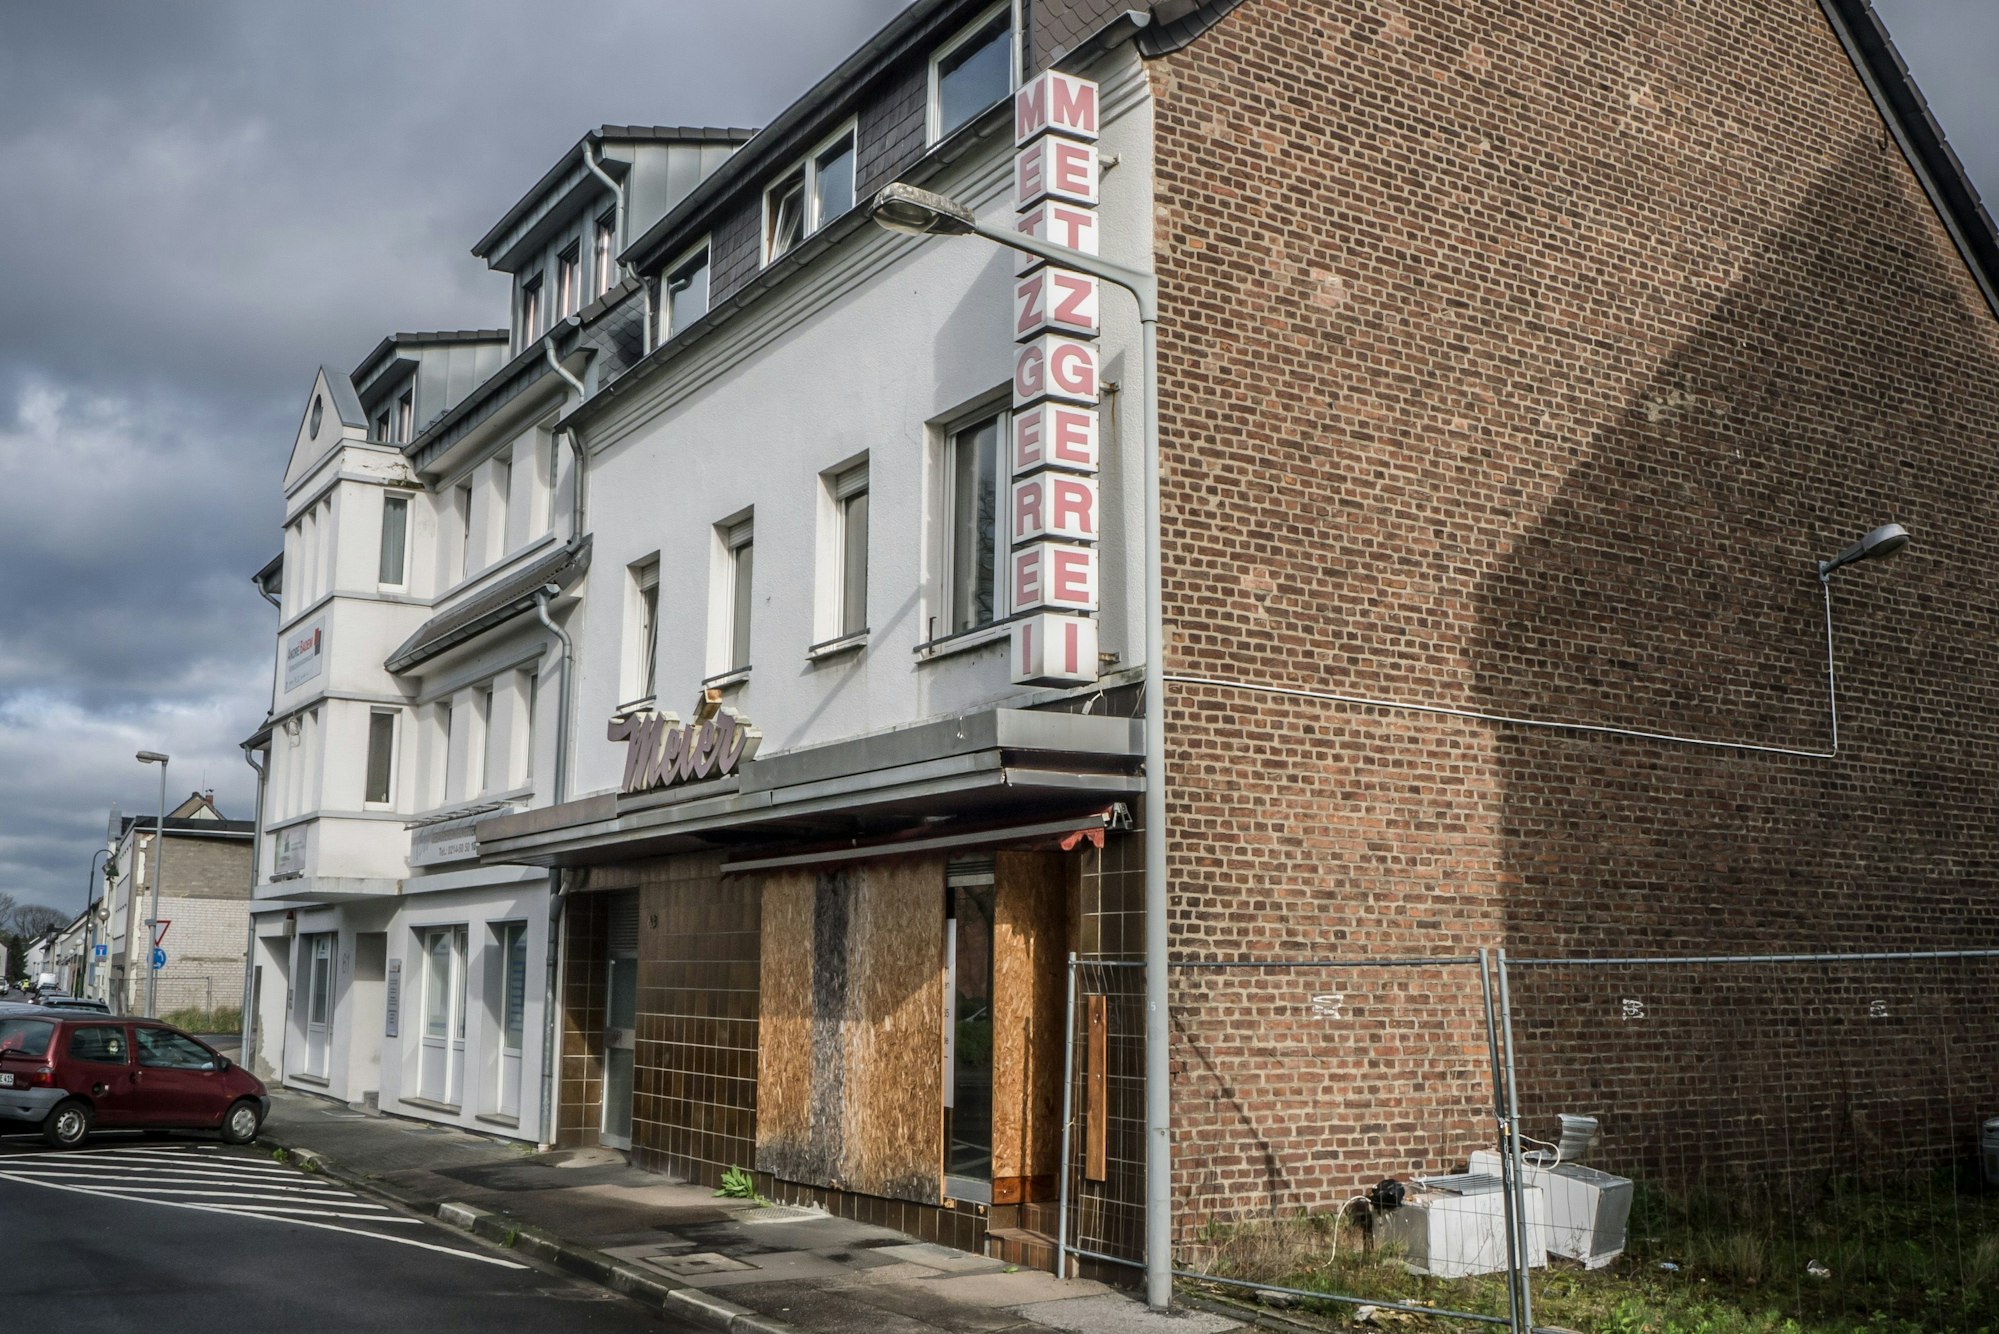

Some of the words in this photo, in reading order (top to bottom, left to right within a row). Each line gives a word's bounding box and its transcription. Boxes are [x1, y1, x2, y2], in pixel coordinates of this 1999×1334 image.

[1016, 78, 1046, 676] METZGEREI
[1051, 76, 1095, 674] METZGEREI
[607, 696, 758, 793] Meier
